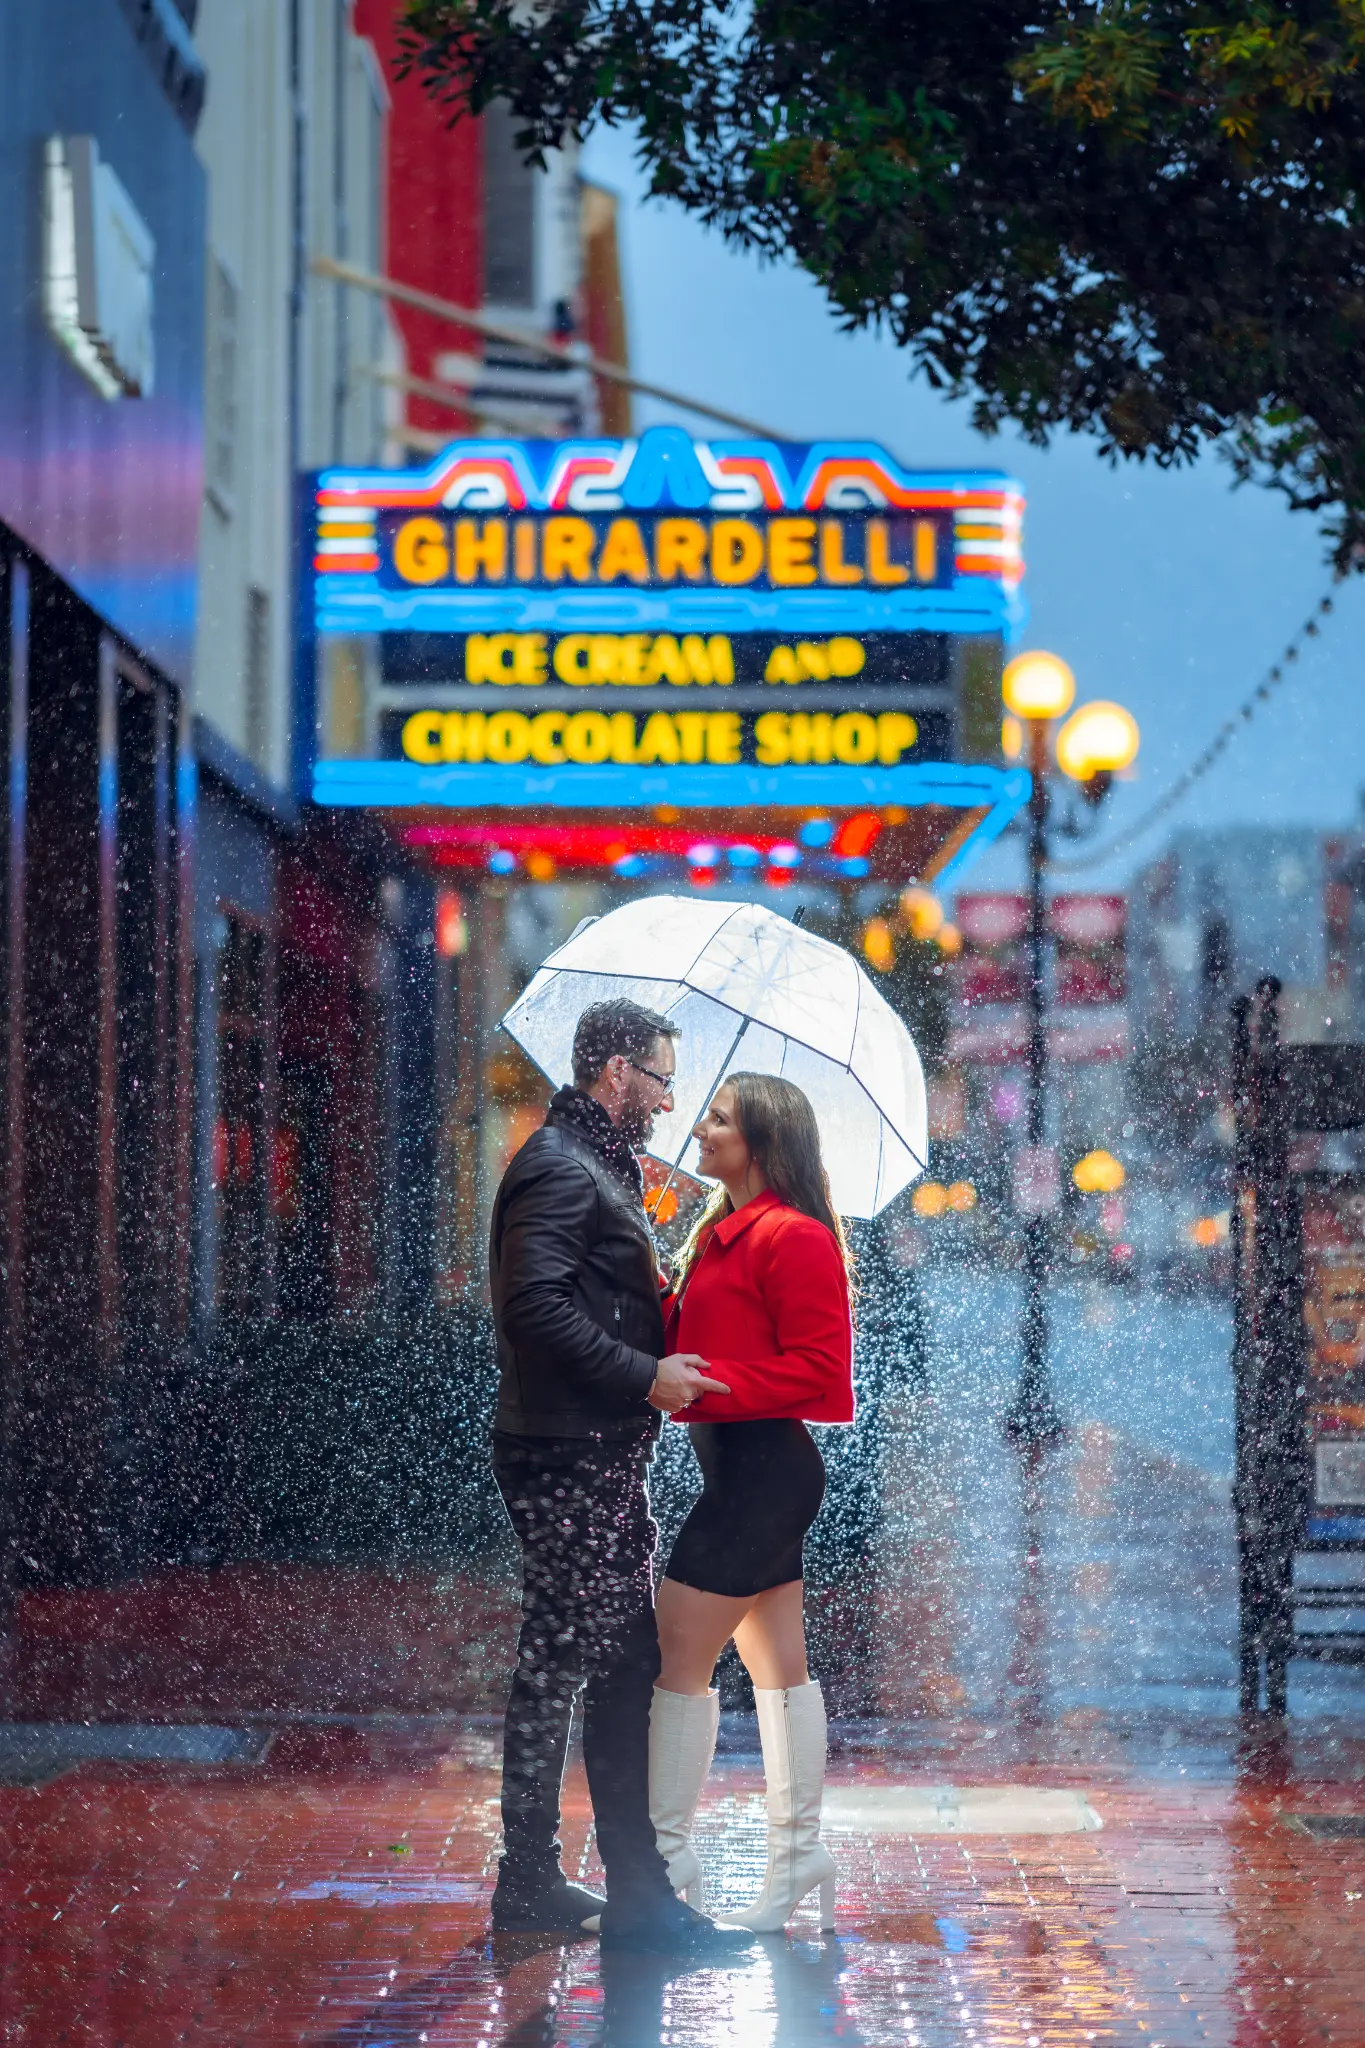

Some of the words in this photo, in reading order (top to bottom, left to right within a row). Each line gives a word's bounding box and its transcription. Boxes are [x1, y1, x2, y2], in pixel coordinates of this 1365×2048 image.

[394, 517, 936, 585] GHIRARDELLI
[465, 634, 548, 686] ICE
[553, 634, 735, 686] CREAM
[764, 636, 866, 685] AND
[402, 711, 741, 764] CHOCOLATE
[755, 712, 917, 764] SHOP
